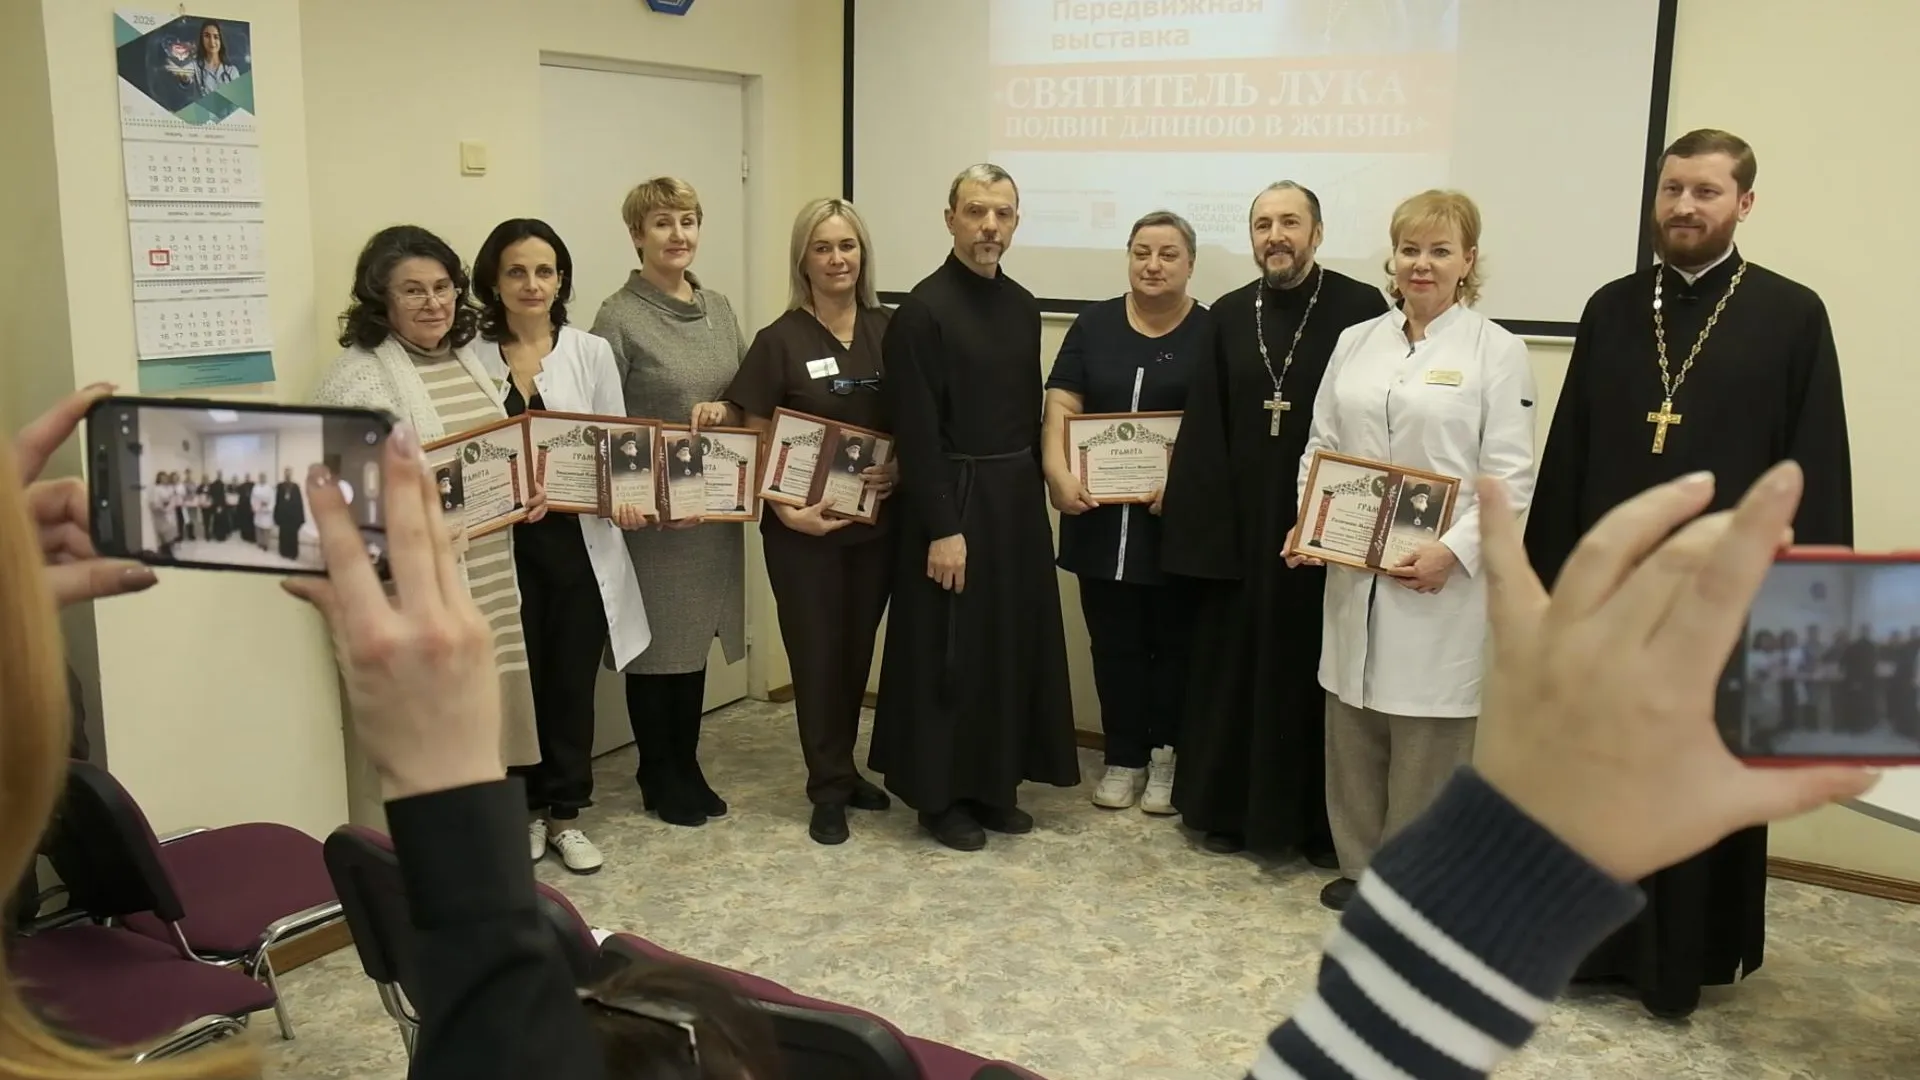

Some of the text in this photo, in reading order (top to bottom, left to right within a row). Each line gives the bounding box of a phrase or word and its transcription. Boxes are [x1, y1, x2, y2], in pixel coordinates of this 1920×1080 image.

[1053, 0, 1264, 24] Передвижная
[1051, 28, 1190, 51] выставка
[1268, 69, 1408, 107] ЛУКА
[1004, 115, 1115, 140] ПОДВИГ
[1119, 114, 1256, 141] ДЛИНОЮ
[1264, 114, 1284, 137] В
